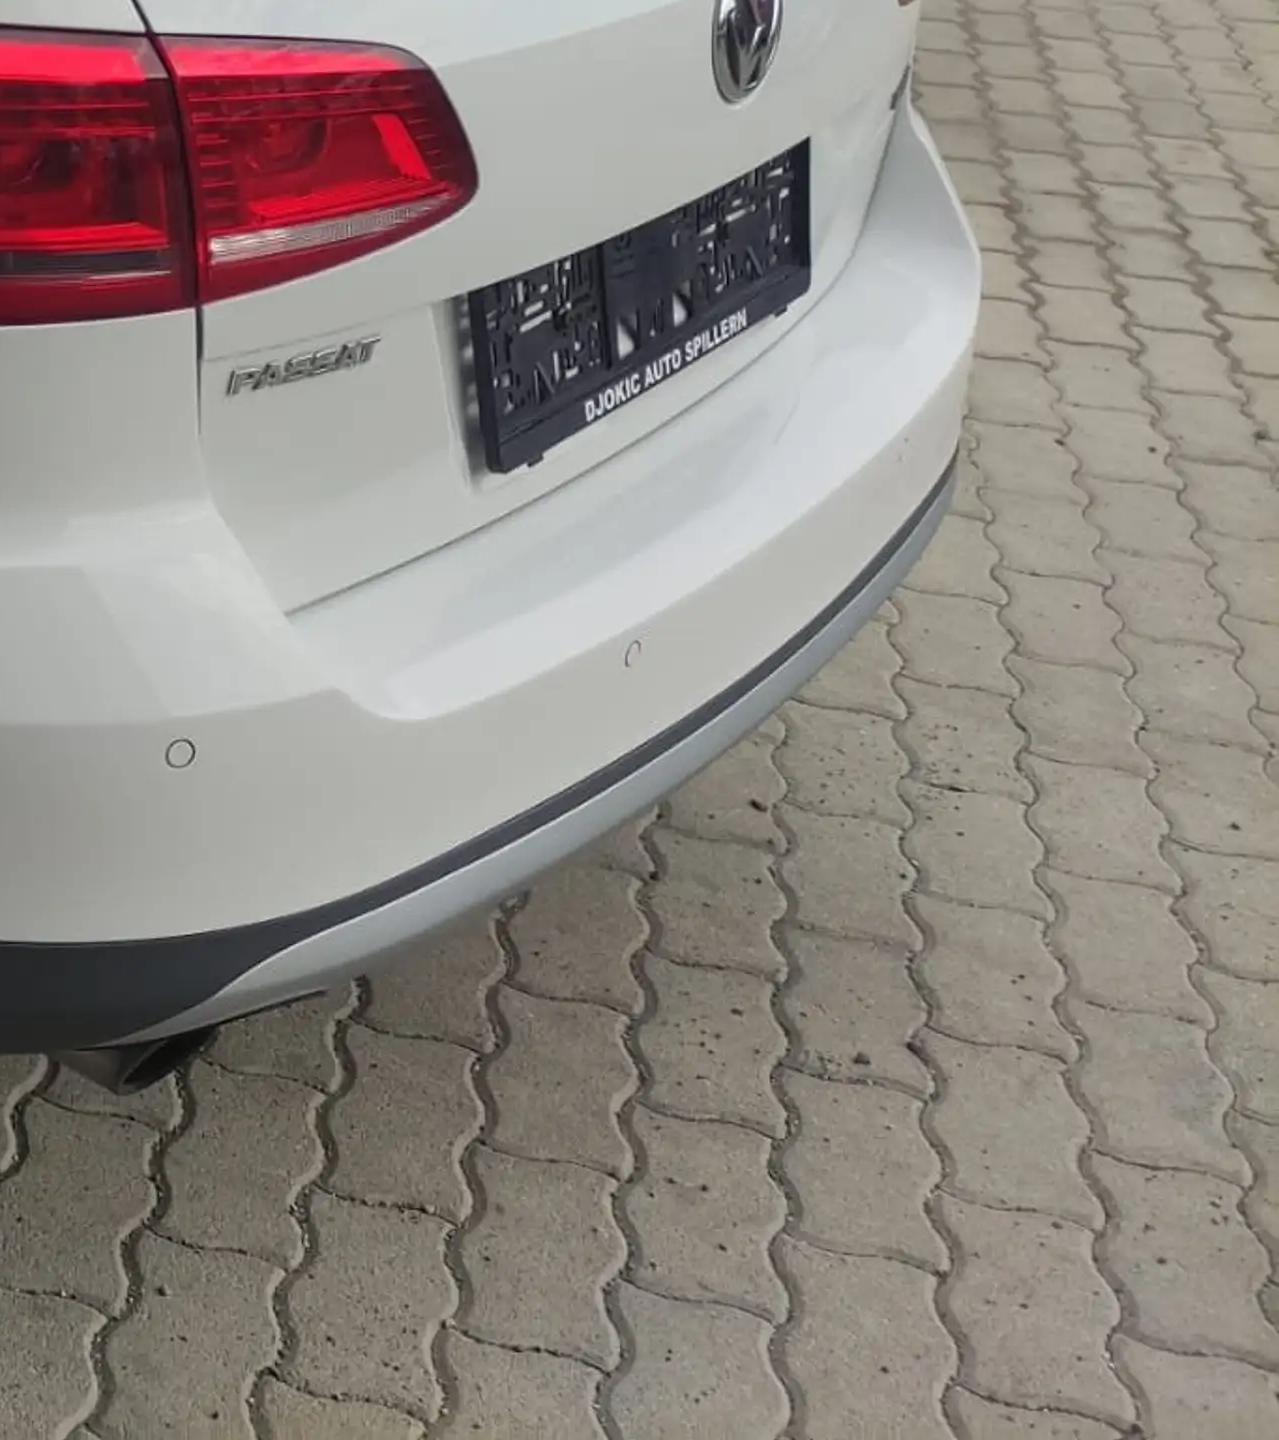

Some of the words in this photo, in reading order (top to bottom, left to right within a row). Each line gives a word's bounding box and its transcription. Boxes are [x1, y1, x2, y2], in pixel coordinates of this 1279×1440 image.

[225, 333, 382, 397] PASSAT
[584, 373, 642, 422] DJOKIC
[644, 348, 682, 388] AUTO
[685, 307, 748, 361] SPILLERN
